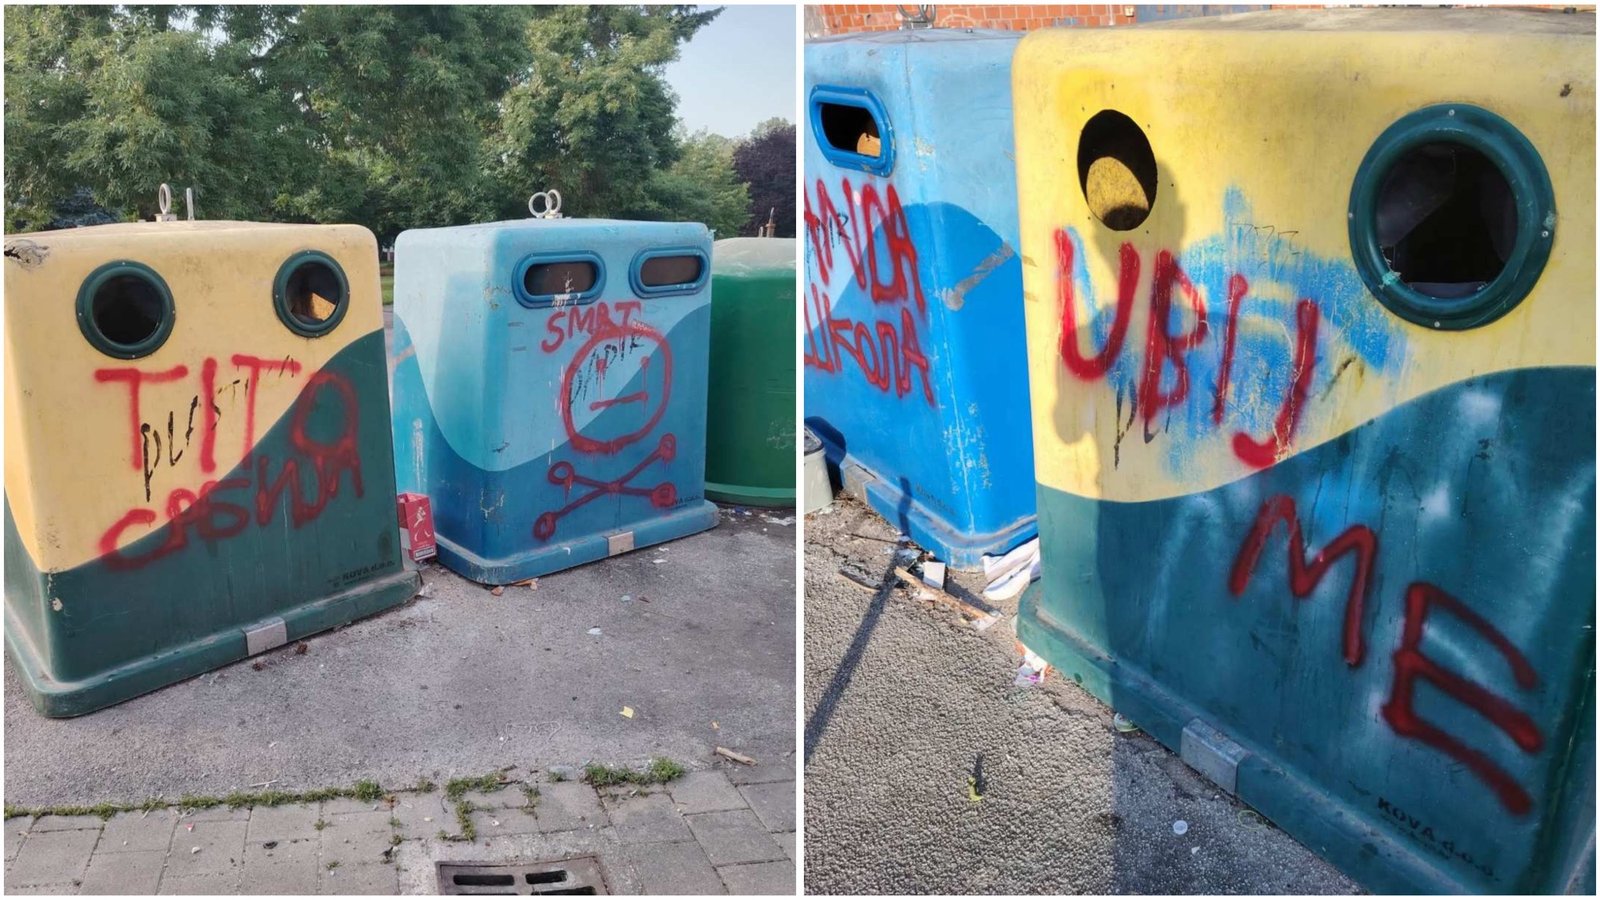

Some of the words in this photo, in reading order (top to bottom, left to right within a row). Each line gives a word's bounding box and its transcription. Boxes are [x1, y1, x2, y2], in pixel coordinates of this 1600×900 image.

[541, 300, 643, 354] SMRT
[1053, 228, 1320, 468] UBIJ
[94, 353, 361, 474] TITO
[1228, 494, 1546, 818] ME
[1378, 796, 1436, 841] KOVA
